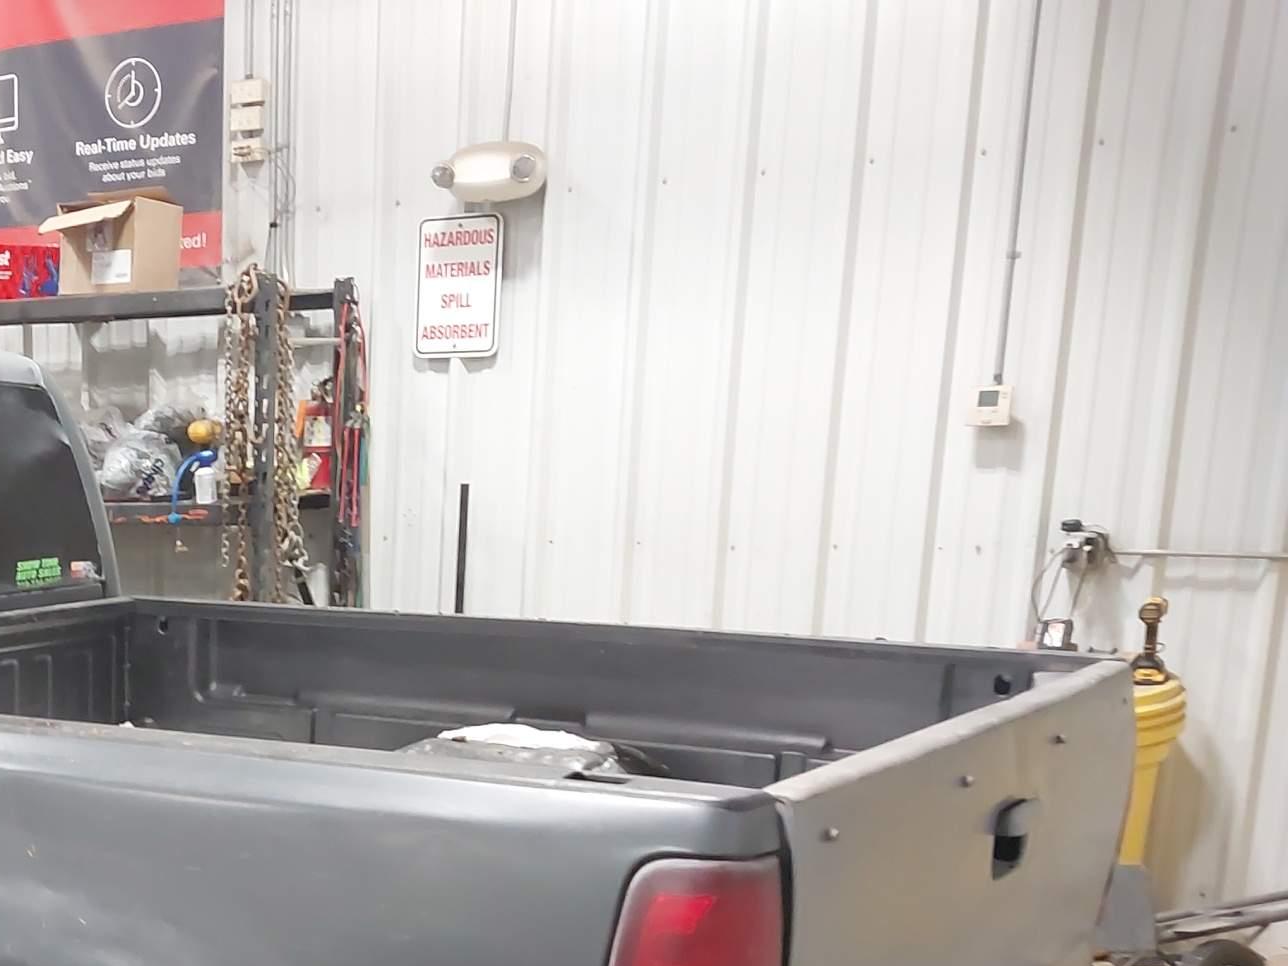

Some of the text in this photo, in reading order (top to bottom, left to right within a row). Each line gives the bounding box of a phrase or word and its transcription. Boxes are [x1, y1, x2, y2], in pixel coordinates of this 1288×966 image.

[75, 132, 197, 156] Real-Time Updates
[6, 149, 33, 165] Easy
[146, 155, 181, 167] updates
[424, 228, 494, 248] HAZARDOUS
[425, 260, 490, 279] MATERIALS
[441, 292, 472, 309] SPILL
[421, 323, 489, 340] ABSORBENT
